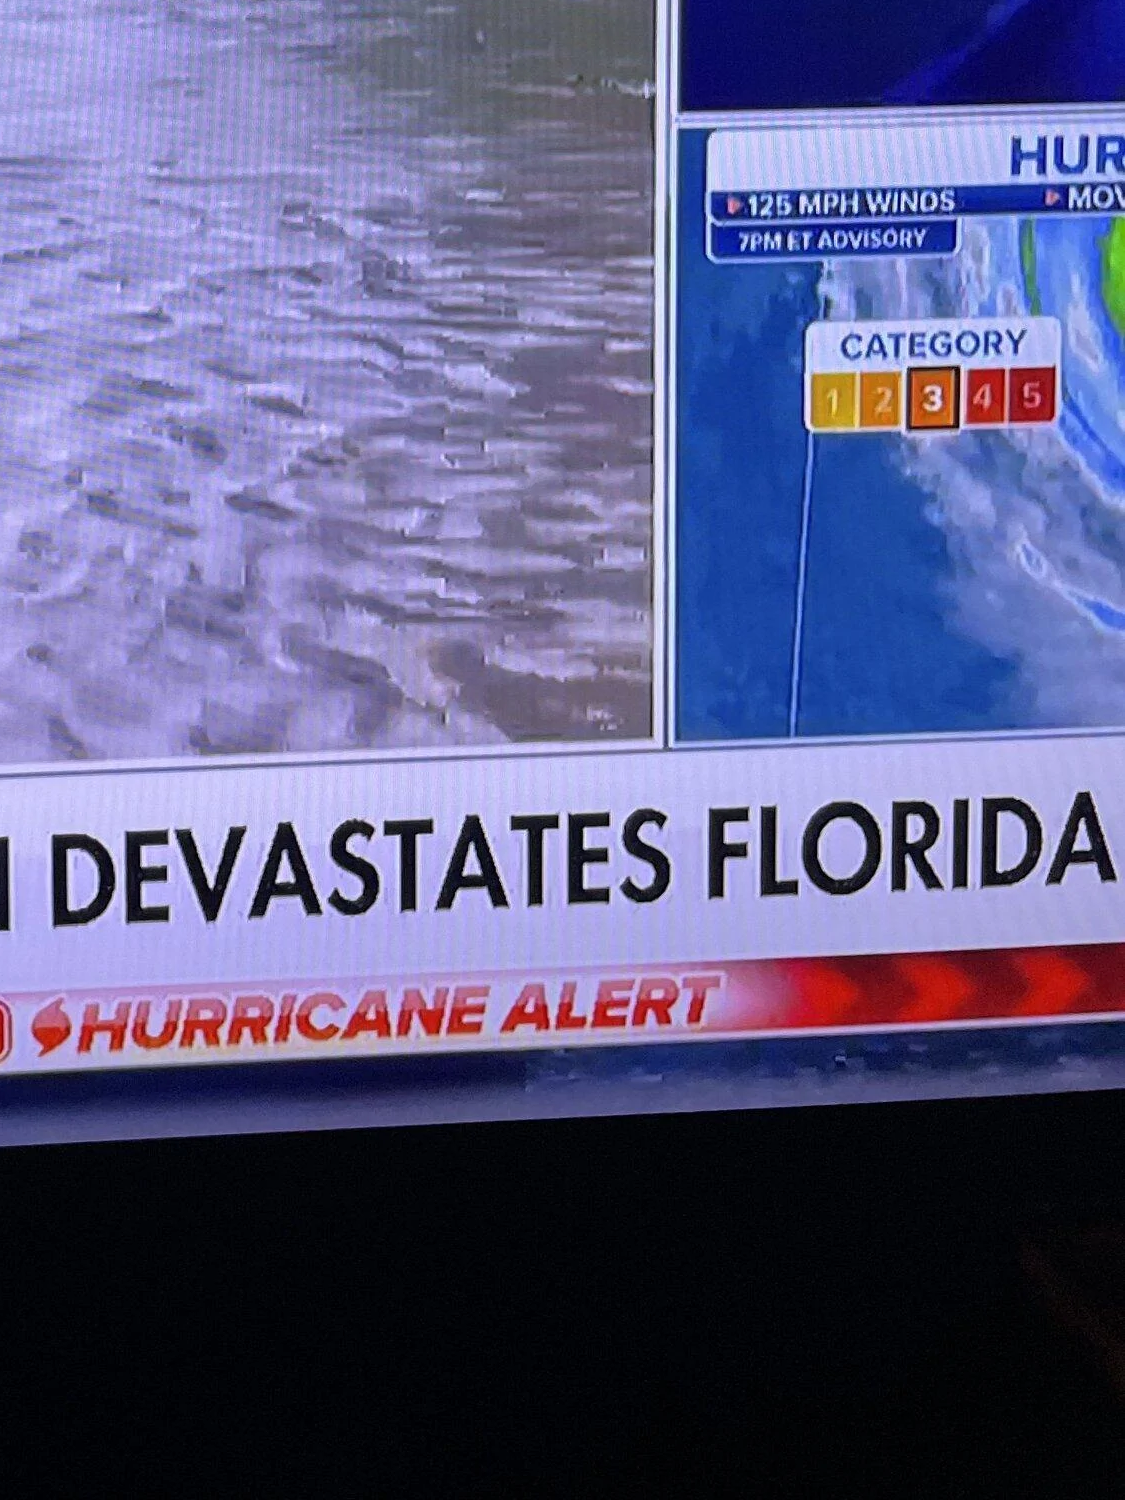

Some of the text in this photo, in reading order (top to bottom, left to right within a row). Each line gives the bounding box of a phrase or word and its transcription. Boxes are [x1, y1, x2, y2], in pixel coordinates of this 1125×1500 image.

[748, 186, 956, 217] 125 MPH WINDS
[739, 227, 928, 252] 7PM ET ADVISORY
[841, 330, 1028, 360] CATEGORY
[826, 381, 1041, 414] 1 2 3 4 5
[52, 808, 669, 932] DEVASTATES
[707, 790, 1118, 902] FLORIDA
[77, 973, 720, 1054] HURRICANE ALERT
